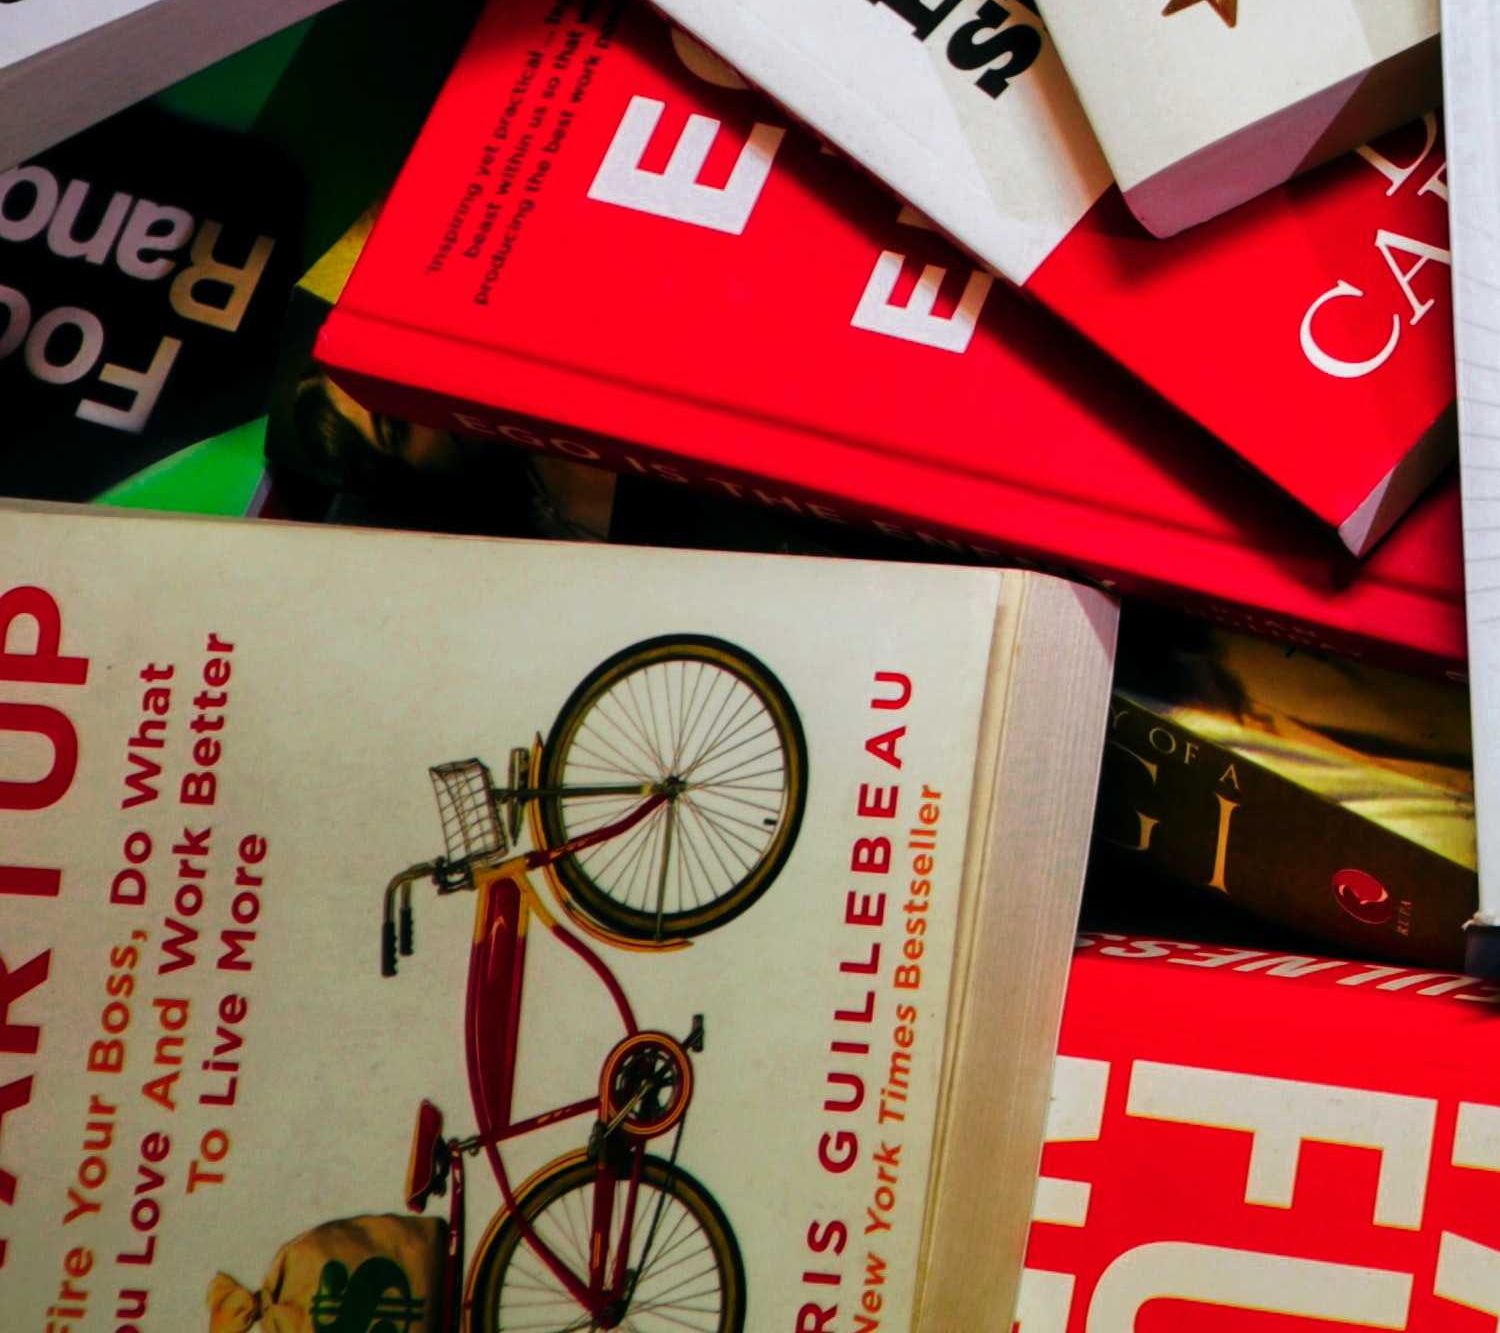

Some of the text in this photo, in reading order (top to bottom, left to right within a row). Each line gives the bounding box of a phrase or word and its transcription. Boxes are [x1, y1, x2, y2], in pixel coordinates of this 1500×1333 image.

[186, 833, 269, 1194] To Live More
[818, 667, 913, 1174] GUILLEBEAU
